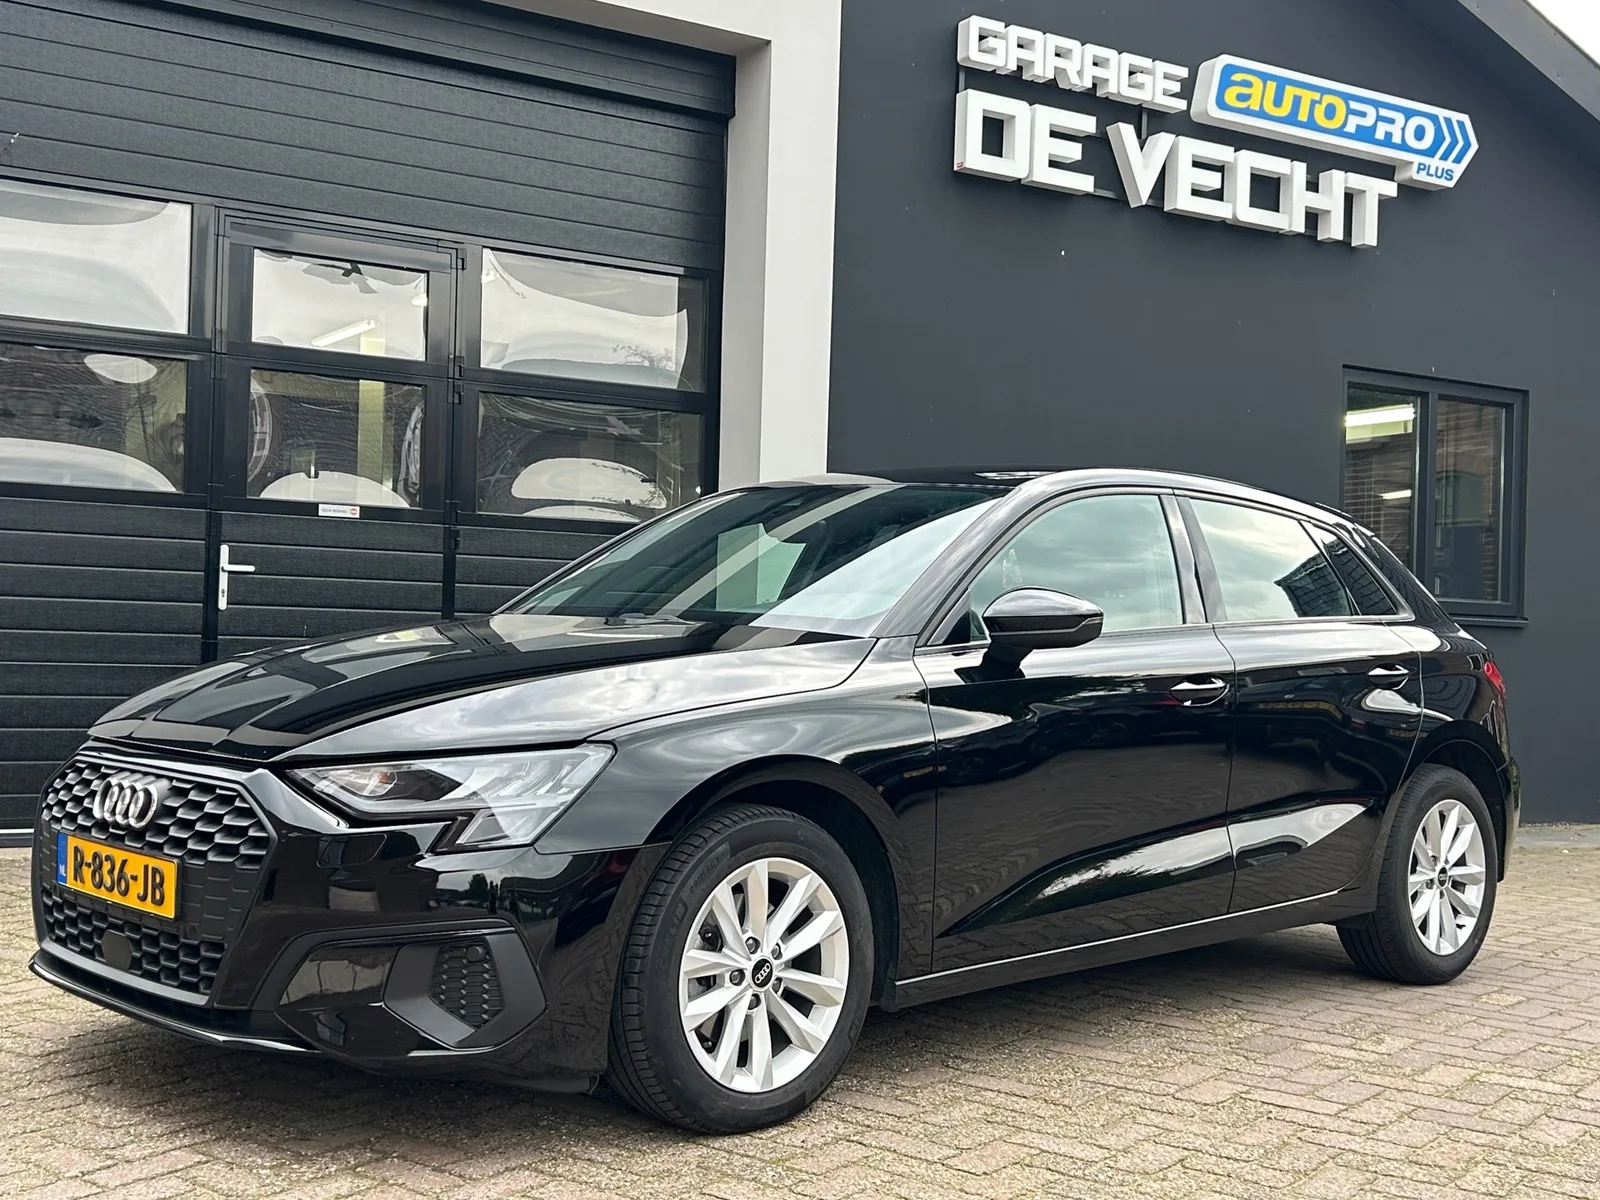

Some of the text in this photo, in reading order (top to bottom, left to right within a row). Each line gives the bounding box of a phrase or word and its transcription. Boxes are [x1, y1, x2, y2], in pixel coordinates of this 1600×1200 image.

[958, 15, 1188, 113] GARAGE
[954, 88, 1398, 247] DE VECHT
[1415, 161, 1456, 182] PLUS
[73, 846, 165, 907] R-836-JB
